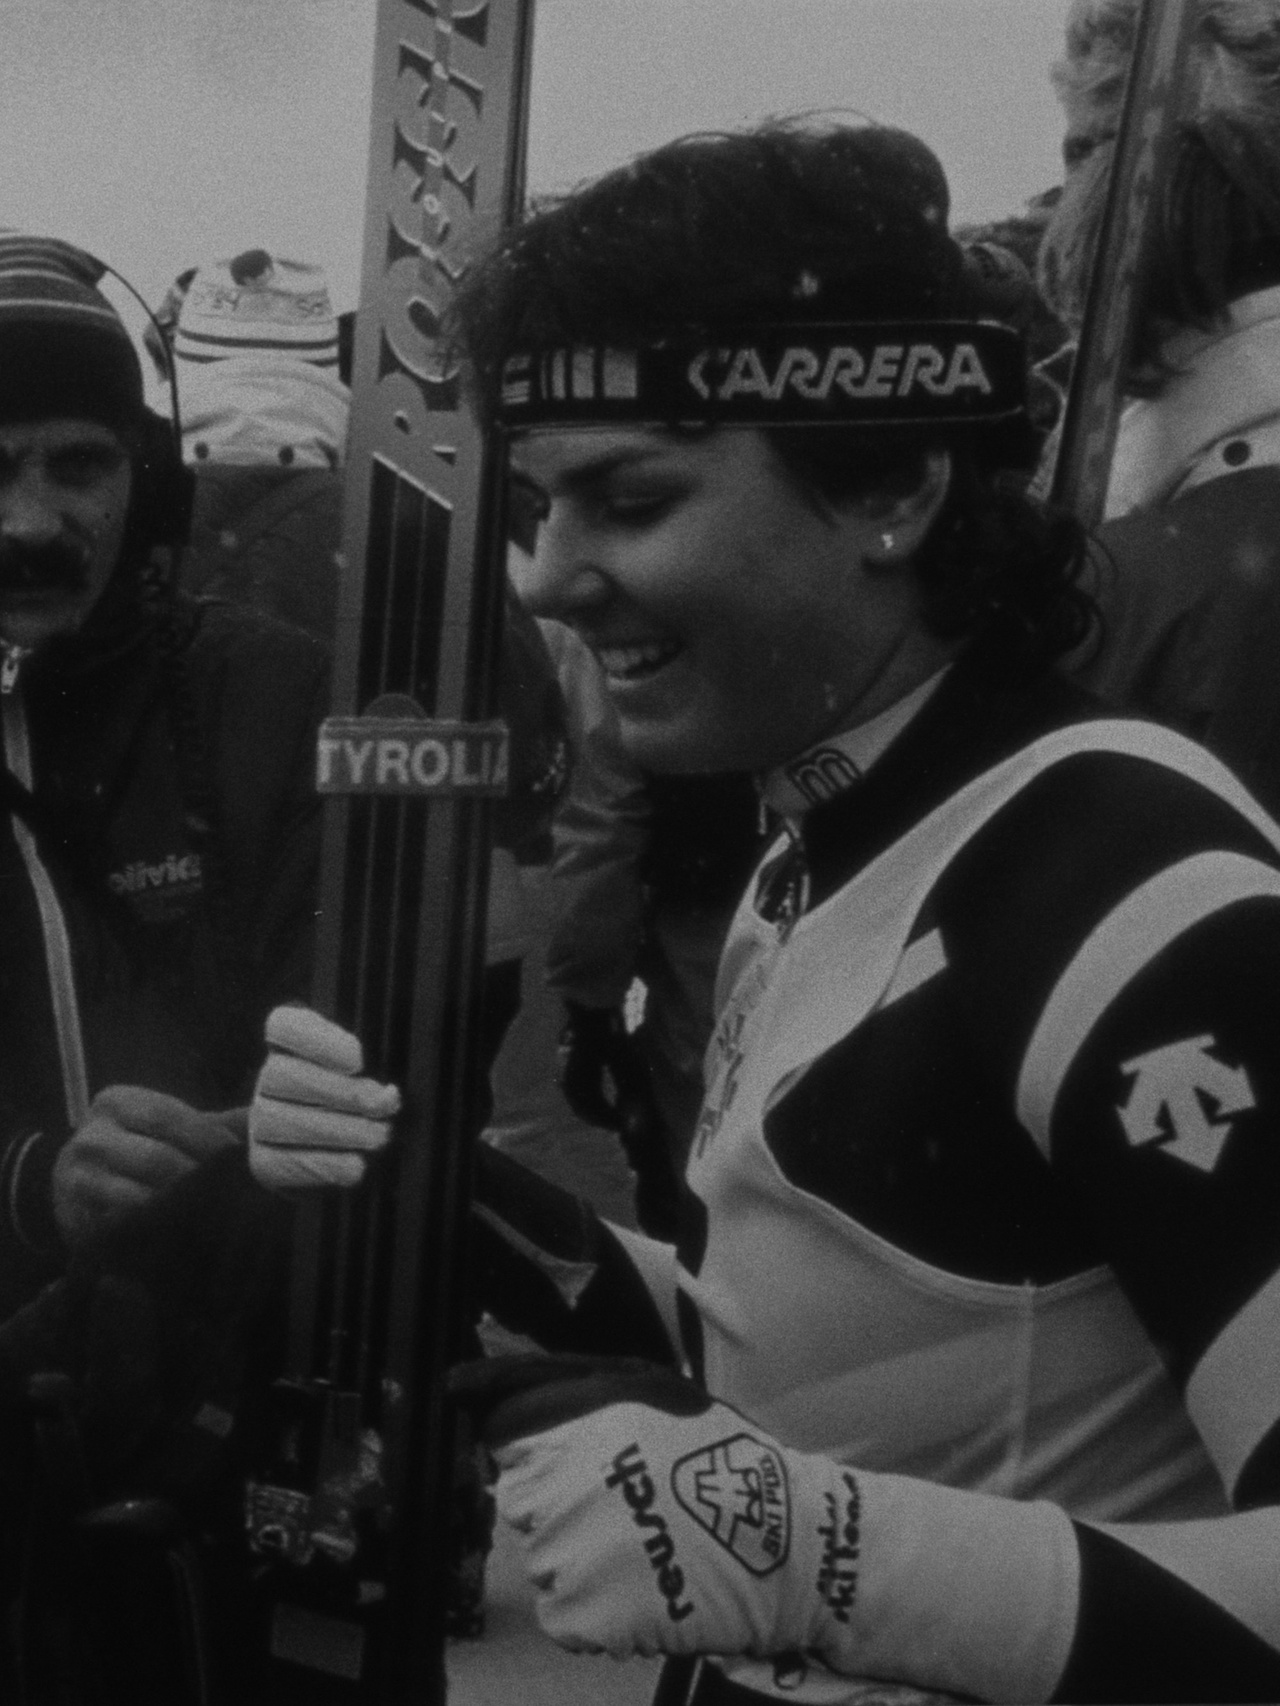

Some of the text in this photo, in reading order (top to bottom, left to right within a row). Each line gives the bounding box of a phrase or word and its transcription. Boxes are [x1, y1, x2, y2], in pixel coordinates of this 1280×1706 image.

[372, 0, 488, 512] ROSSI
[686, 344, 993, 400] CARRERA
[606, 1442, 694, 1622] reusch
